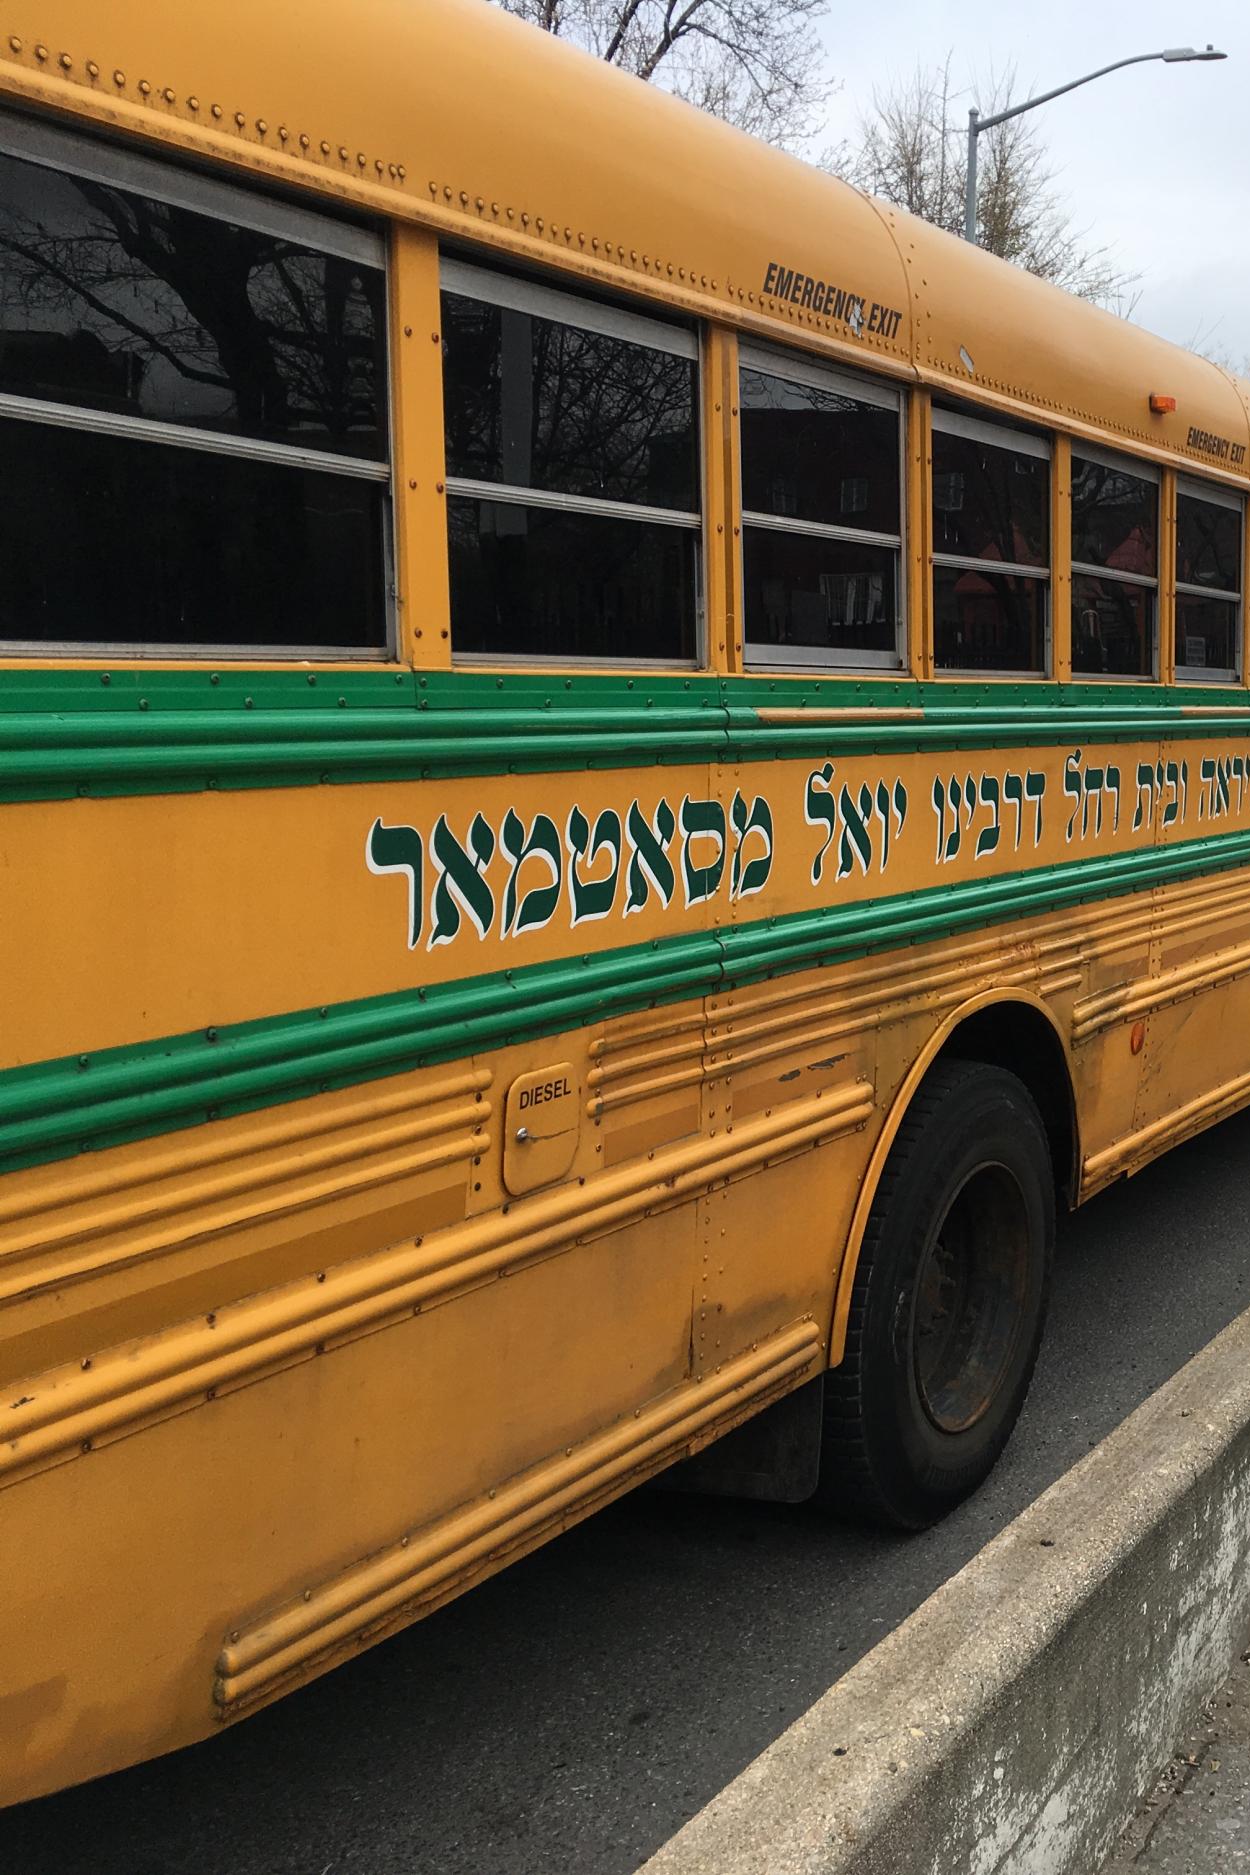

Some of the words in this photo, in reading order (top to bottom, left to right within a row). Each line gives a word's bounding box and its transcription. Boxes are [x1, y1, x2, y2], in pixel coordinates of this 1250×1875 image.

[763, 262, 866, 325] EMERGENCY
[867, 303, 902, 339] EXIT
[1187, 426, 1230, 459] EMERGENCY
[1230, 443, 1246, 465] EXIT
[805, 761, 908, 886] יואל
[931, 767, 1046, 865] דרבינו
[1064, 748, 1120, 843] רחל
[1132, 758, 1188, 833] ובית
[365, 788, 774, 952] מסאטמאר
[519, 1078, 572, 1110] DIESEL
